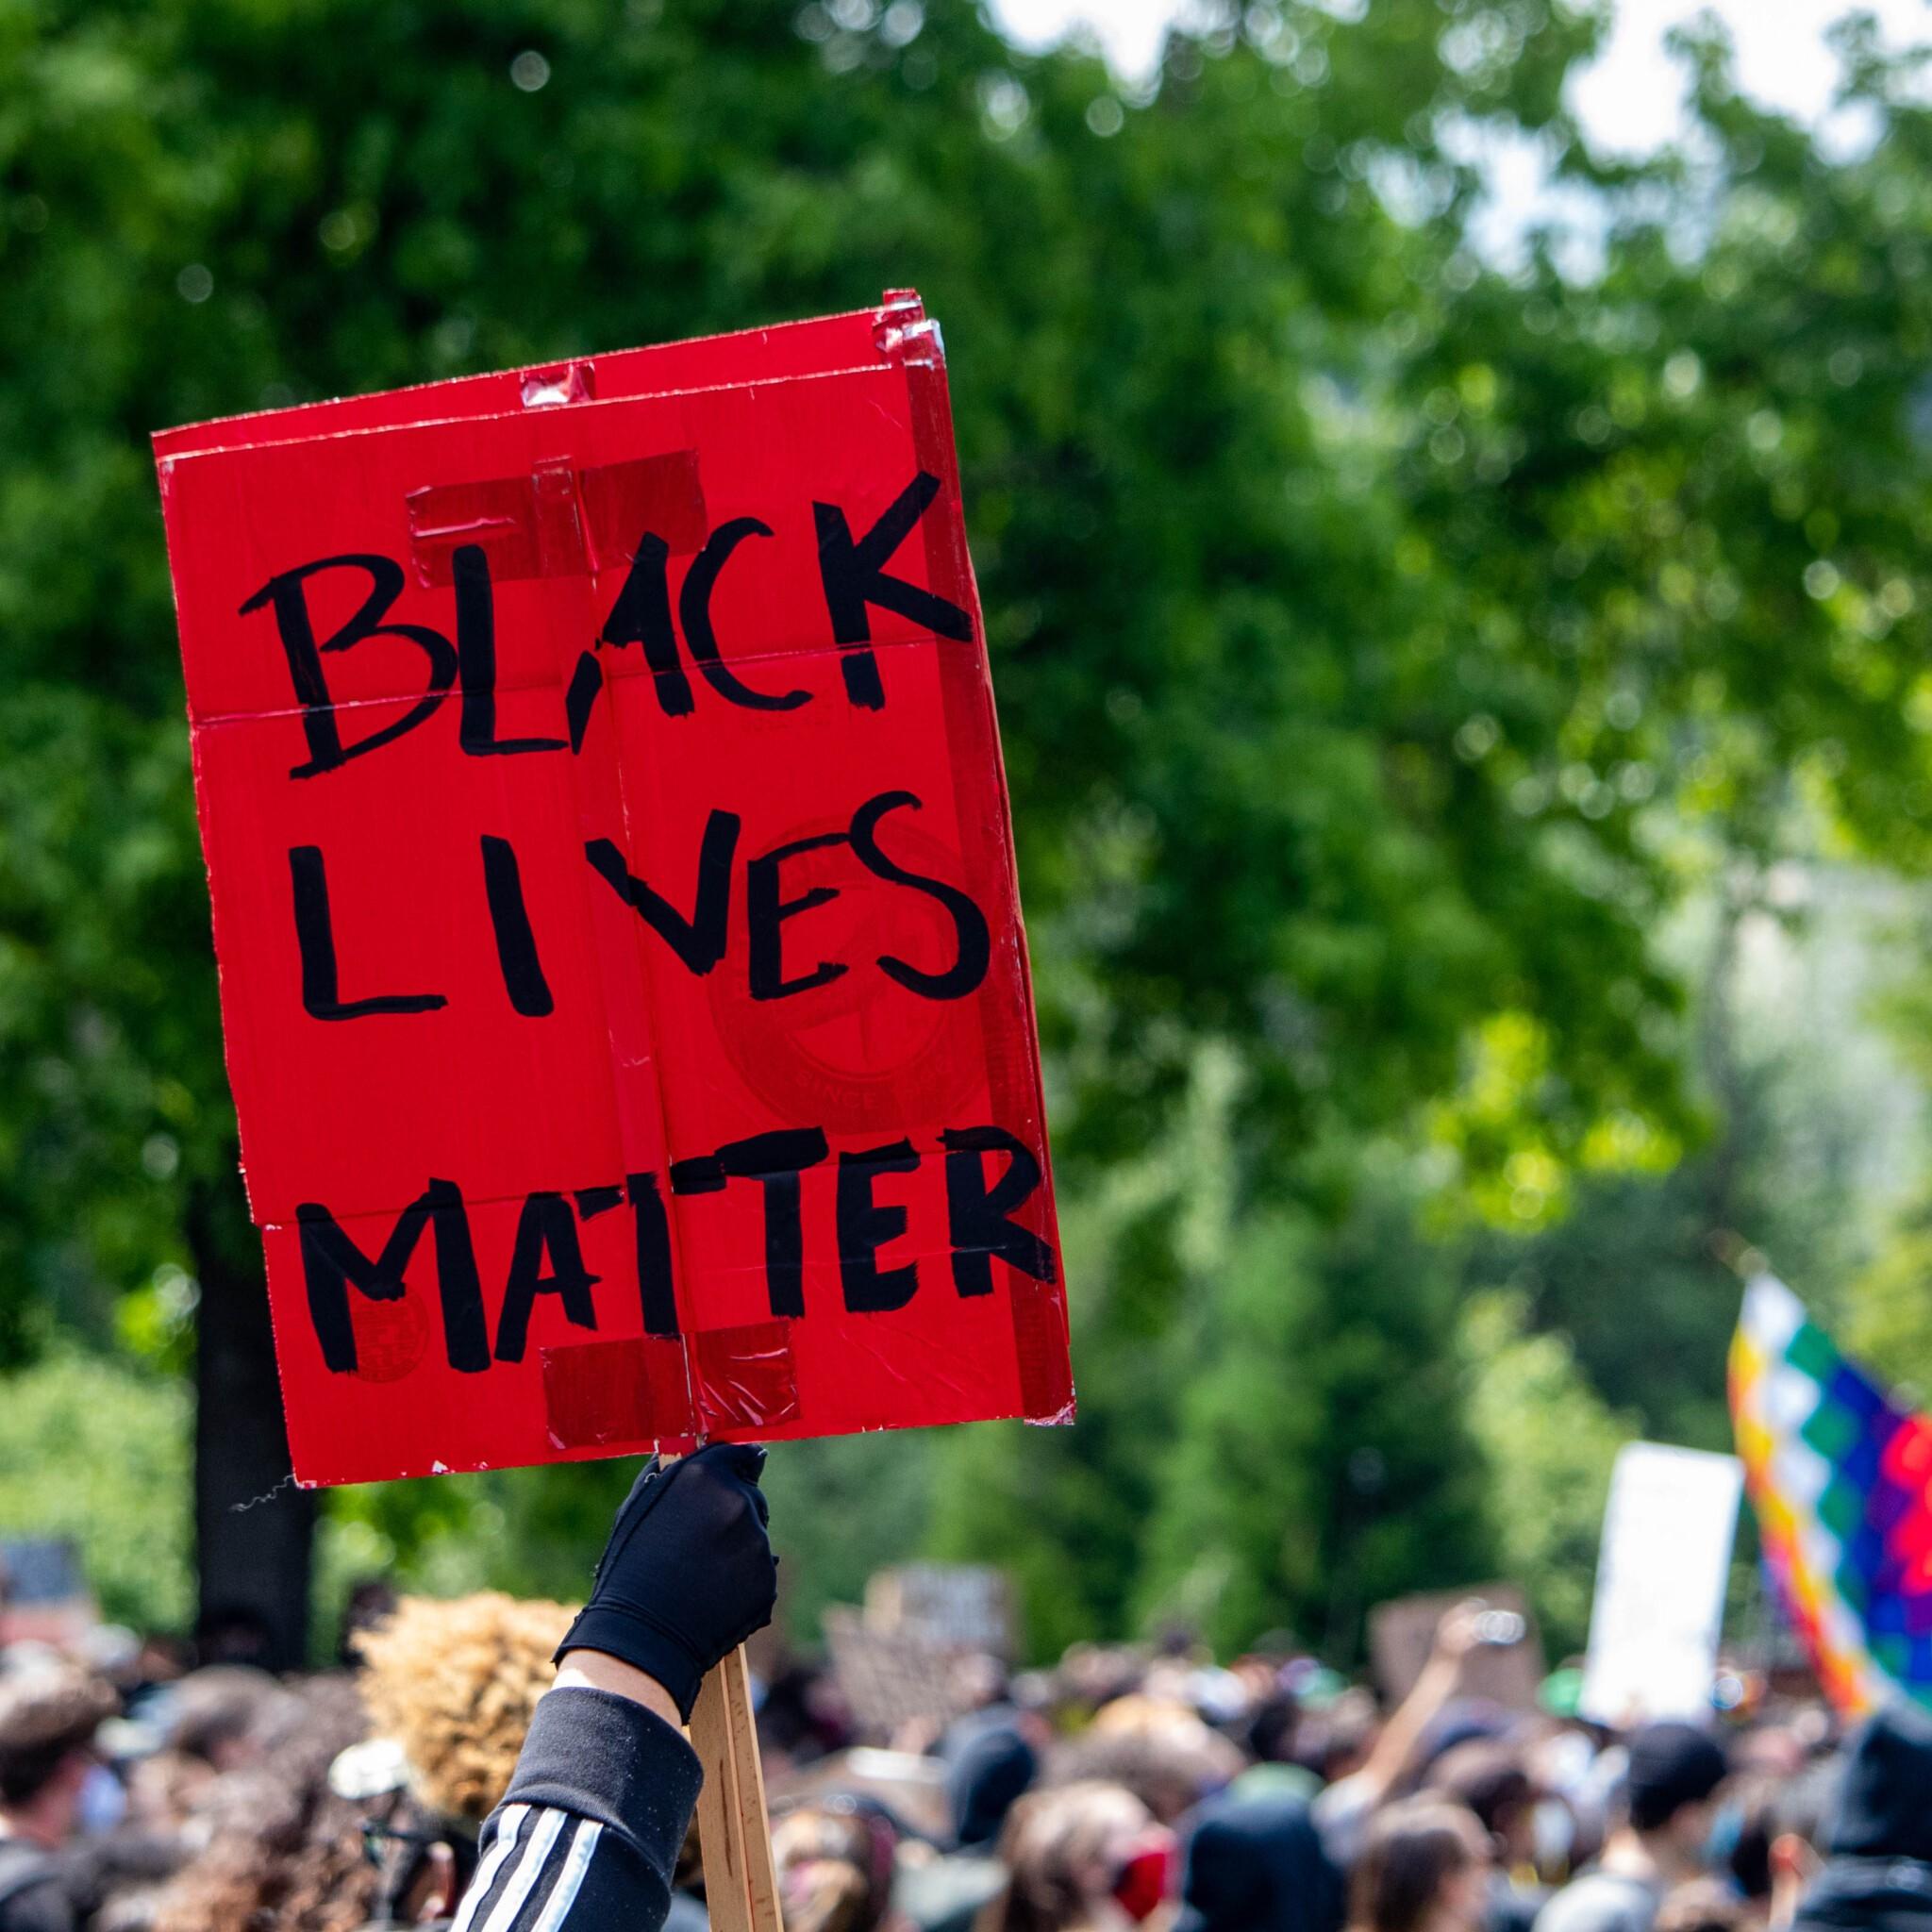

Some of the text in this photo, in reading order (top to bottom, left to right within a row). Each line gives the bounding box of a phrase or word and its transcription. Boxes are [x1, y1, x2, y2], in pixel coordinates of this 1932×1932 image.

[240, 470, 974, 780] BLACK
[289, 791, 991, 1022] LIVES
[295, 1125, 1057, 1374] MATTER
